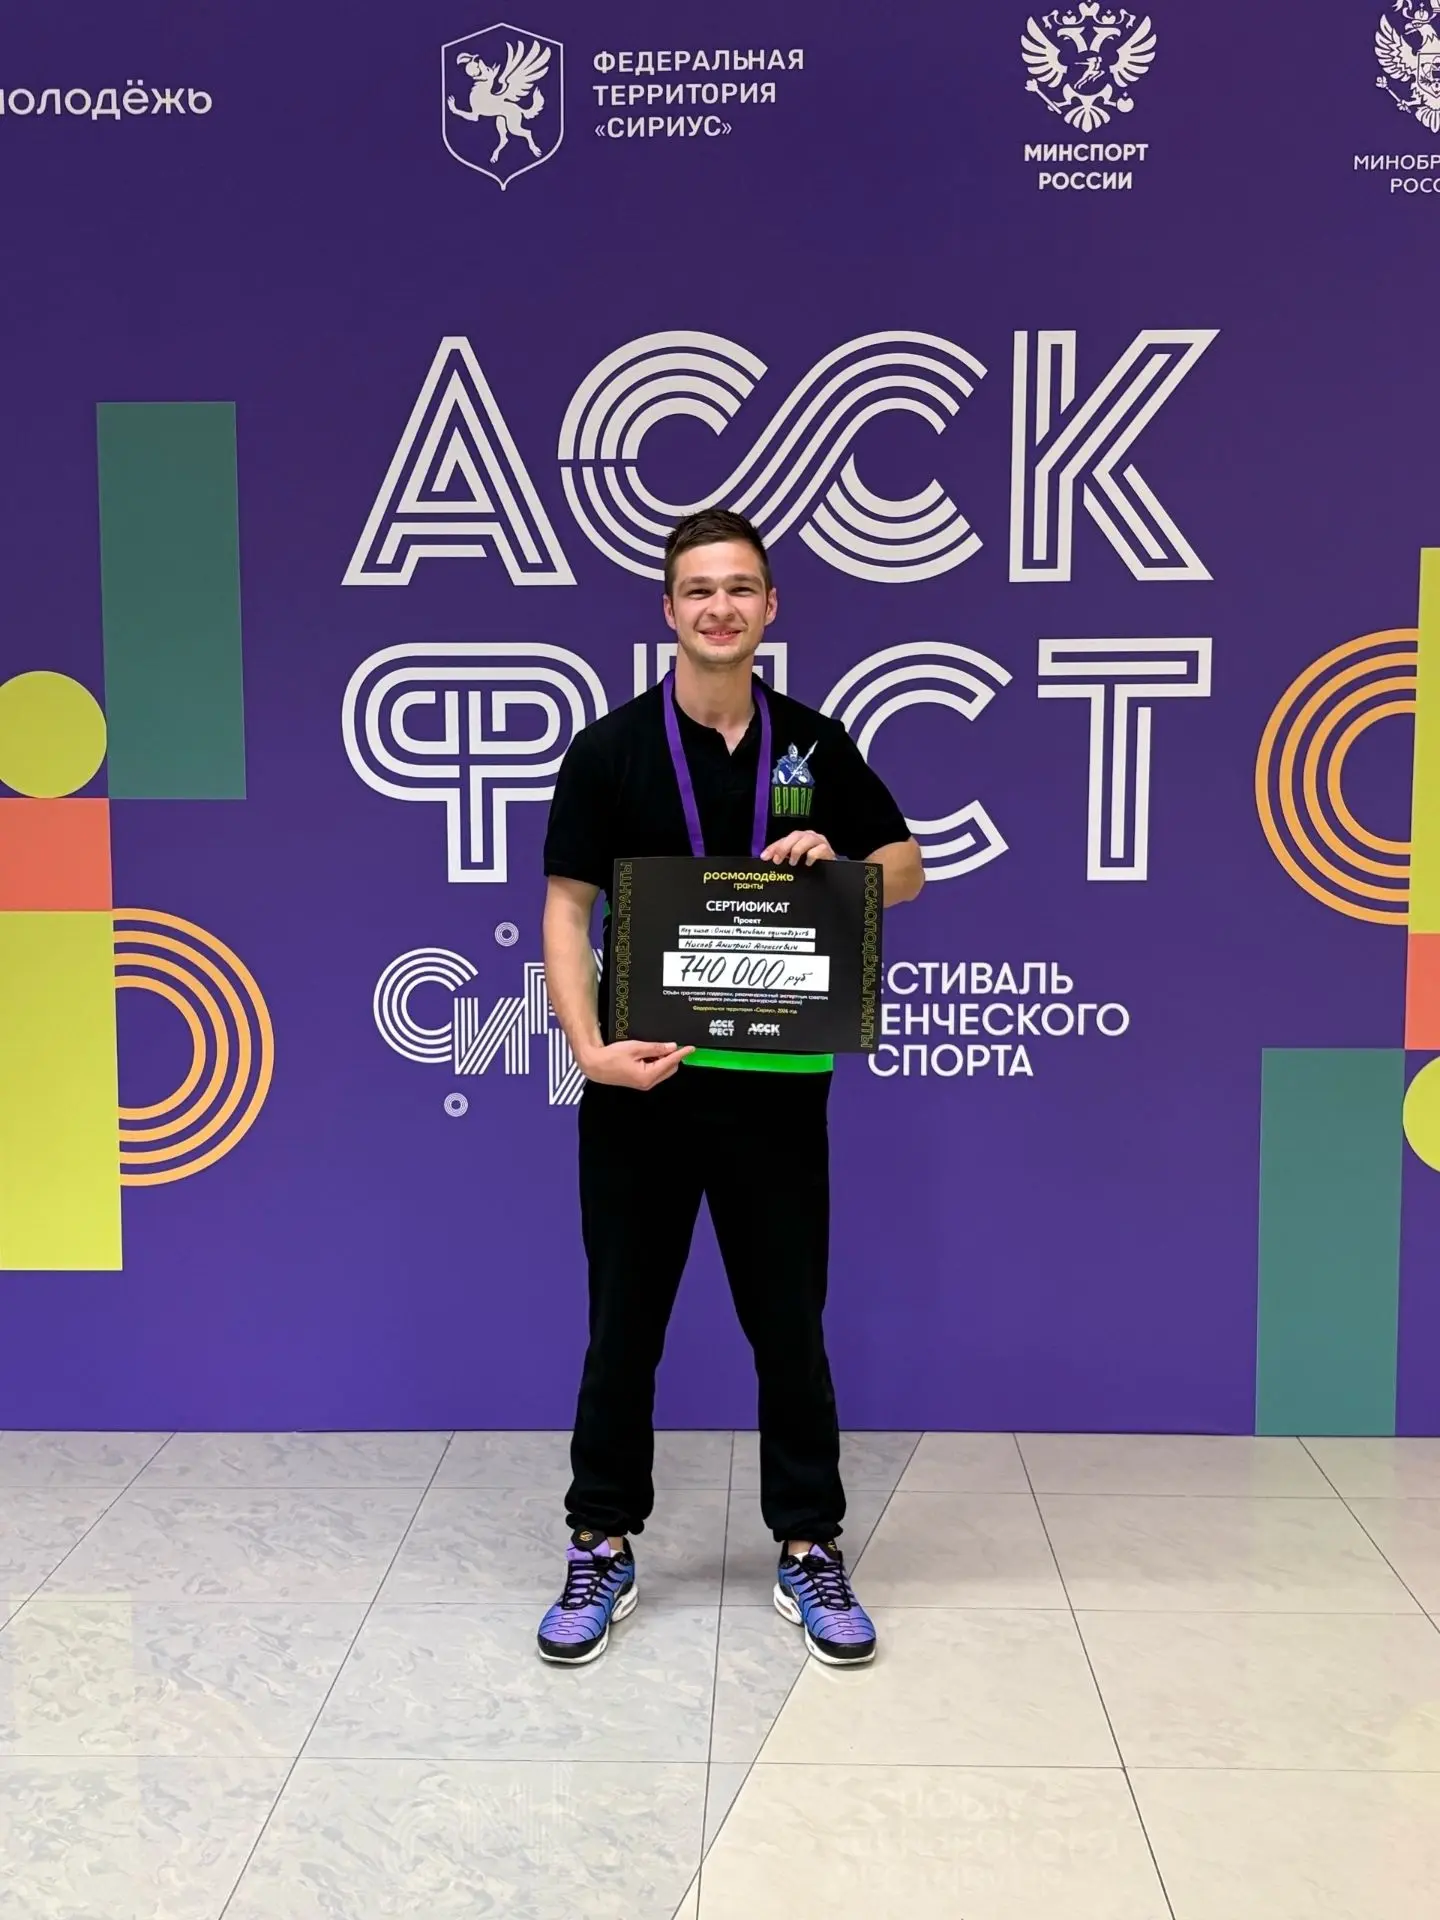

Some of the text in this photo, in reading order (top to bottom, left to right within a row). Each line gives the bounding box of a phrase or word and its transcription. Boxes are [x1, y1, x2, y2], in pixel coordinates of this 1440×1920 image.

[593, 49, 804, 76] ФЕДЕРАЛЬНАЯ
[592, 82, 776, 106] ТЕРРИТОРИЯ
[594, 115, 732, 138] «СИРИУС»
[1024, 143, 1149, 162] МИНСПОРТ
[1353, 154, 1440, 170] МИНОБР
[1039, 171, 1133, 190] РОССИИ
[341, 329, 1221, 586] АССК
[703, 871, 794, 884] росмолодёжь
[733, 882, 764, 891] гранты
[705, 900, 790, 913] СЕРТИФИКАТ
[733, 916, 762, 925] Проект
[680, 955, 727, 984] 740
[732, 956, 785, 989] 000
[881, 962, 1074, 995] СТИВАЛЬ
[709, 1019, 735, 1028] АССК
[748, 1022, 780, 1034] АССК
[881, 1003, 1130, 1036] ЕНЧЕСКОГО
[709, 1027, 735, 1037] ФЕСТ
[868, 1043, 1034, 1077] СПОРТА
